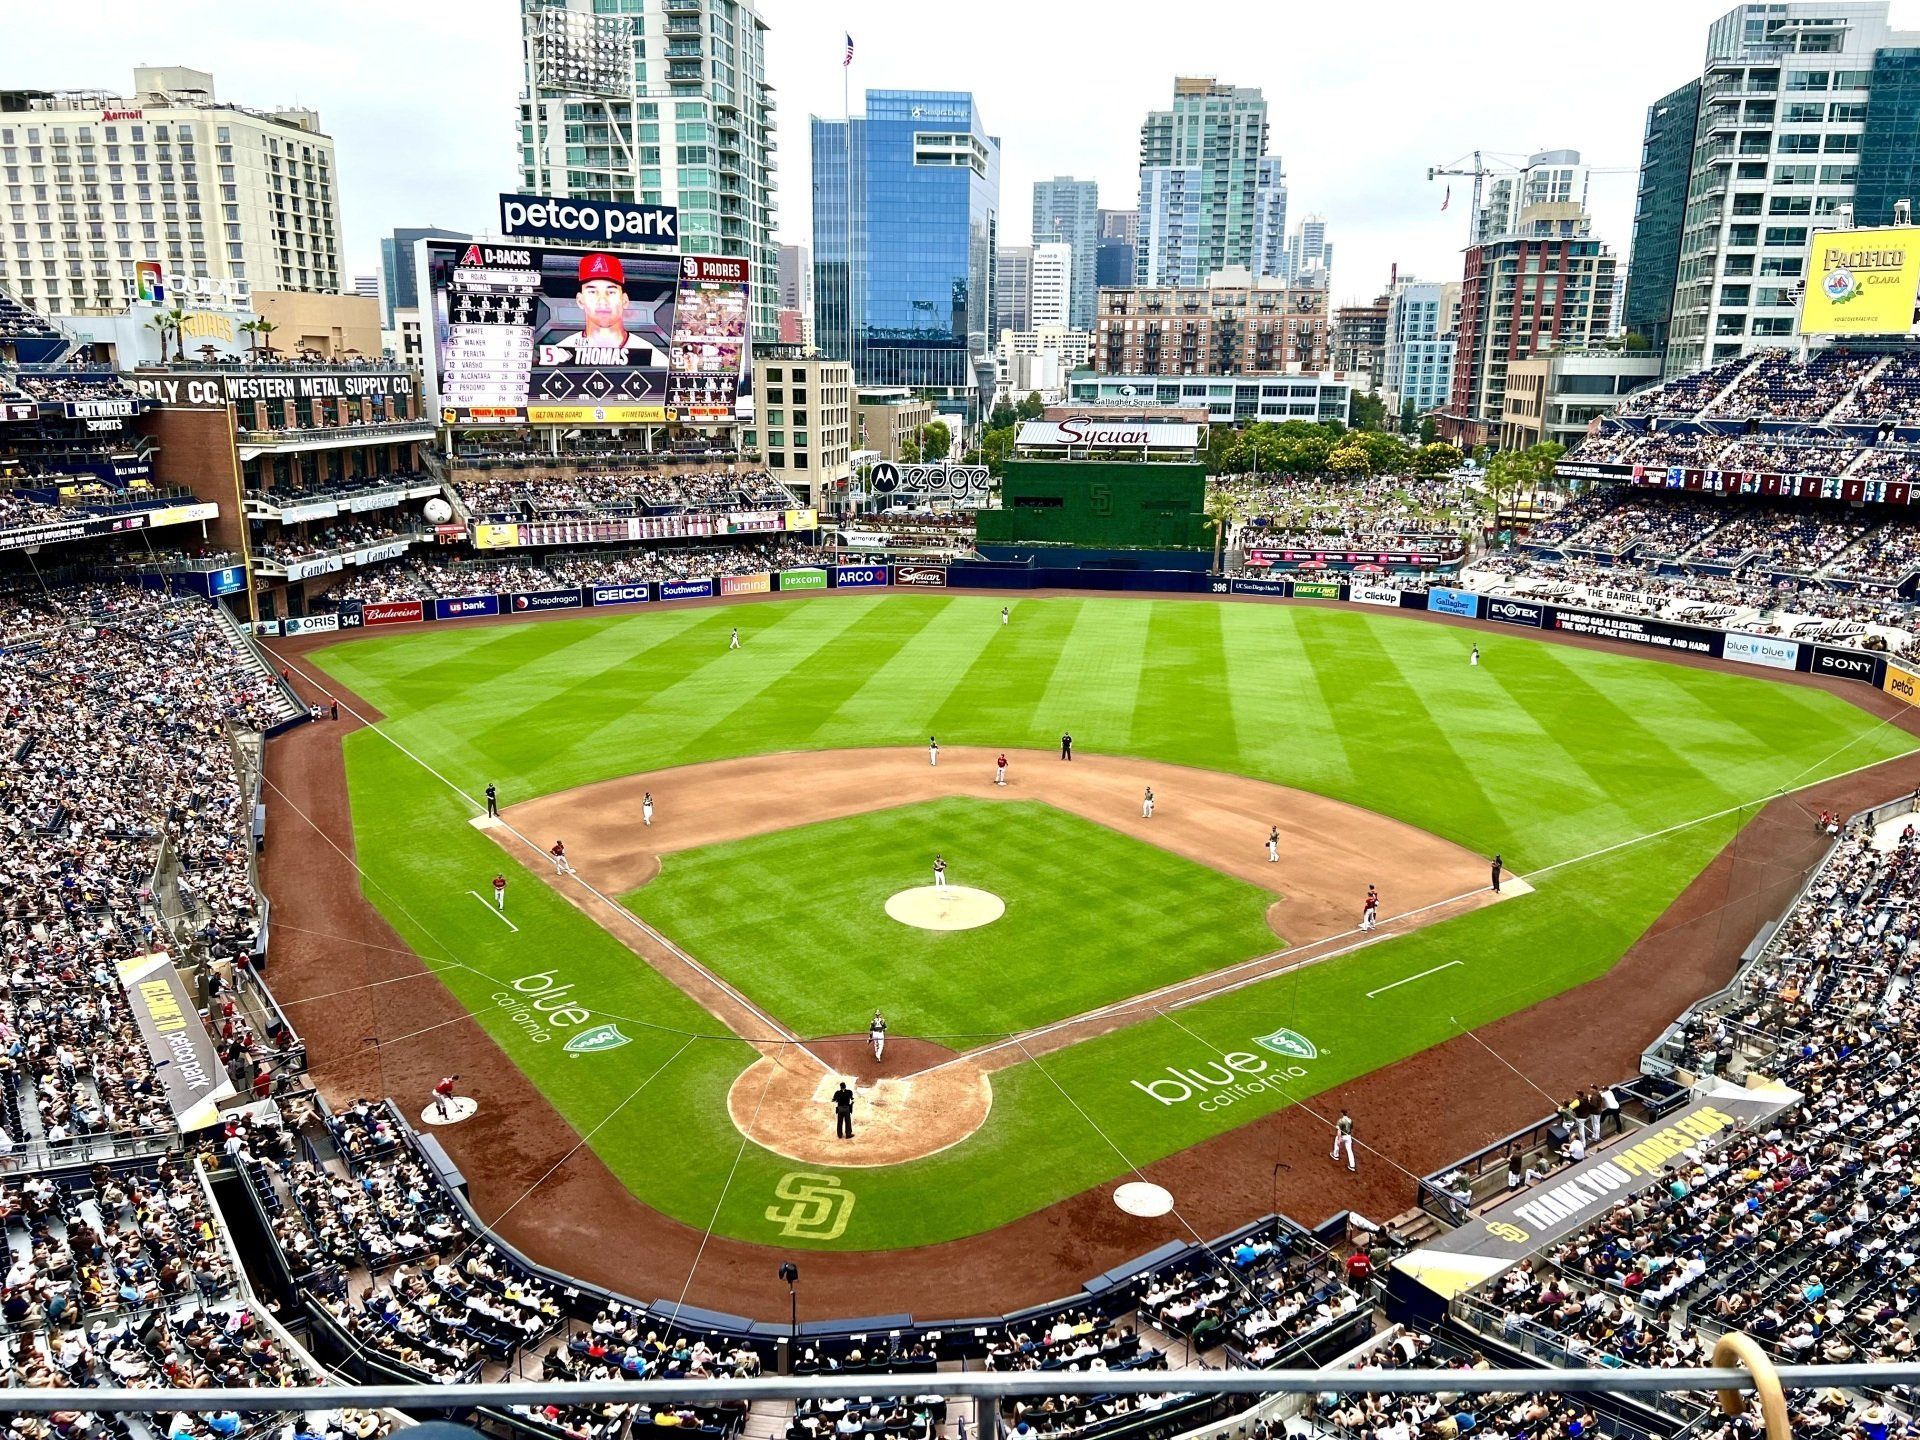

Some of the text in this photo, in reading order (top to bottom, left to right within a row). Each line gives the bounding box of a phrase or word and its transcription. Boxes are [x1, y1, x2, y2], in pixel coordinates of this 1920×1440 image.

[102, 110, 142, 121] Marriott
[504, 200, 675, 240] petco park
[485, 249, 531, 265] D-BACKS
[703, 262, 740, 277] PADRES
[1867, 275, 1901, 285] CLARA
[466, 327, 483, 335] MARTE
[464, 338, 486, 346] WALKER
[546, 347, 554, 362] 5
[574, 347, 630, 366] THOMAS
[226, 377, 412, 399] WESTERN METAL SUPPLY CO.
[555, 381, 562, 389] K
[592, 381, 604, 390] 1B
[633, 381, 640, 390] K
[188, 381, 226, 405] CO.
[75, 401, 132, 417] CUTWATER
[1094, 398, 1161, 407] Gallagher Square
[535, 411, 546, 419] GET
[87, 419, 123, 431] SPIRITS
[1056, 416, 1151, 451] Sycuan
[907, 463, 990, 500] edge
[1692, 474, 1698, 484] F
[1730, 477, 1736, 487] F
[1769, 479, 1775, 490] F
[1809, 481, 1816, 492] F
[1851, 485, 1858, 495] F
[1895, 488, 1902, 499] F
[367, 546, 396, 563] Canel's
[301, 560, 334, 578] Canel's
[898, 567, 941, 584] Sycuan
[838, 571, 874, 583] ARCO
[256, 579, 269, 591] 336
[663, 584, 704, 596] Southwest
[724, 578, 767, 593] illumina
[1213, 582, 1227, 592] 396
[532, 595, 578, 606] Snapdragon
[595, 587, 648, 602] GEICO
[1365, 591, 1397, 603] ClickUp
[1588, 589, 1671, 608] THE BARREL DECK
[462, 600, 486, 610] bank
[1436, 597, 1470, 610] Gallagher
[365, 608, 420, 620] Budweiser
[1438, 607, 1466, 616] INSURANCE
[1492, 603, 1538, 618] EVOTEK
[304, 616, 335, 628] ORIS
[342, 613, 360, 626] 342
[1556, 612, 1644, 632] SAN DIEGO GAS & ELECTRIC
[1562, 621, 1710, 653] THE 100-FT SPACE BETWEEN HOME AND HARM
[1727, 640, 1749, 651] blue
[1761, 645, 1785, 657] blue
[1822, 656, 1872, 673] SONY
[1891, 678, 1914, 697] petco
[510, 969, 590, 1027] blue
[491, 992, 552, 1043] california
[160, 1030, 198, 1064] petco
[173, 1058, 212, 1091] park
[1130, 1051, 1268, 1106] blue
[1198, 1066, 1308, 1112] california
[1512, 1180, 1599, 1232] THANK
[1579, 1161, 1632, 1196] YOU
[1611, 1127, 1697, 1177] PADRES
[765, 1172, 857, 1240] SD
